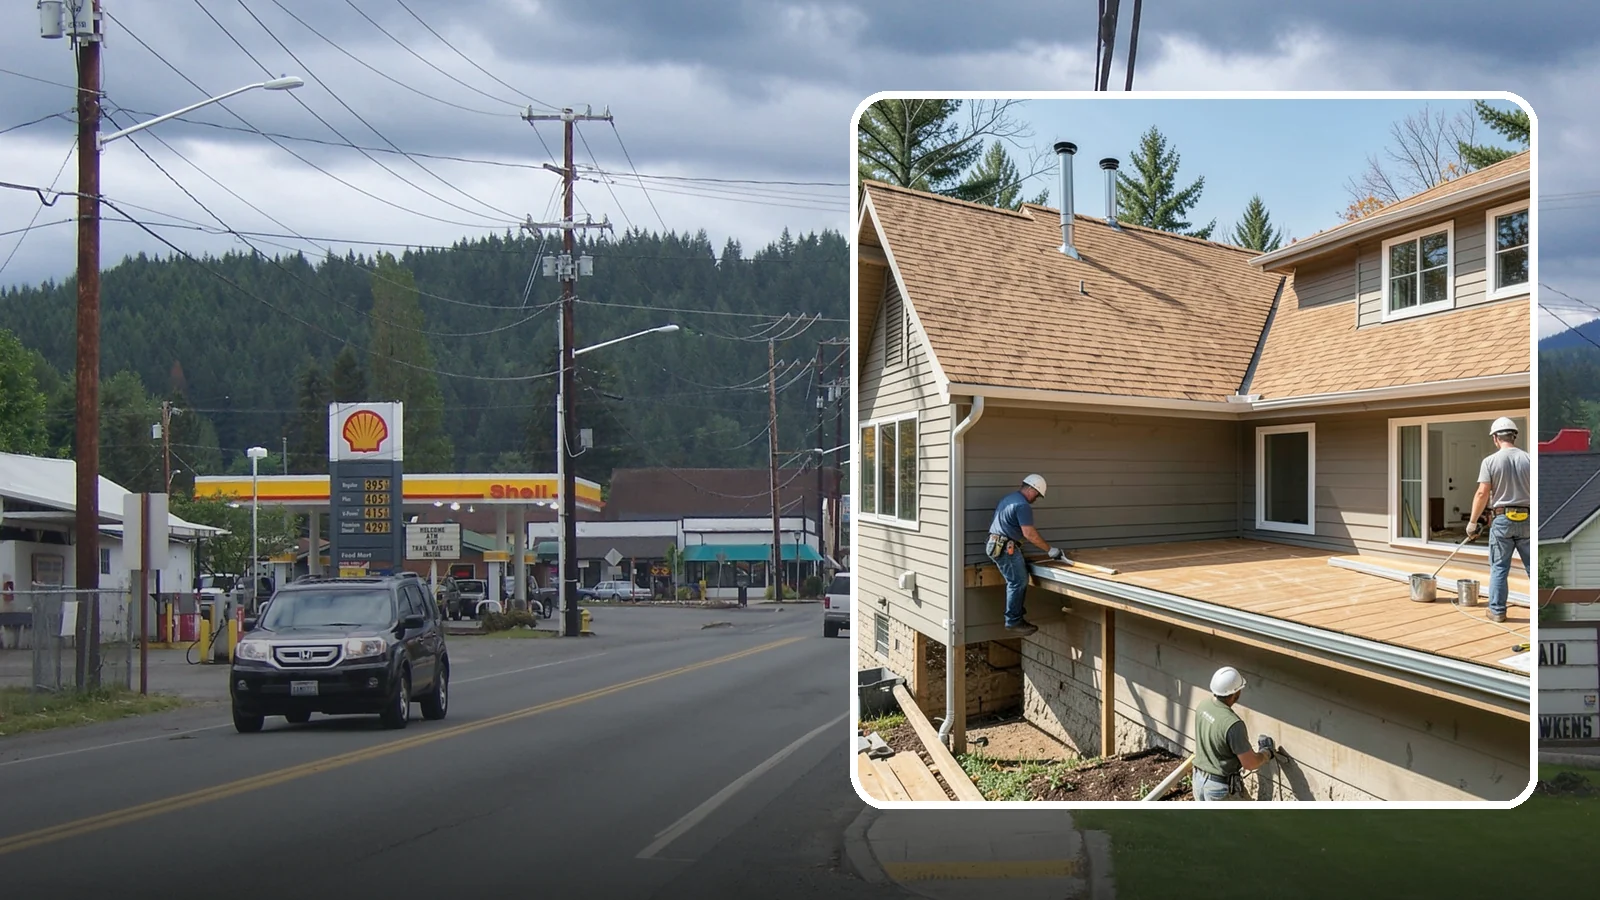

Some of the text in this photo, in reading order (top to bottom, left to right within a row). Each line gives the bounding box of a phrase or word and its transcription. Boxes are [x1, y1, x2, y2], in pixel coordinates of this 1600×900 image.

[366, 480, 384, 490] 395
[490, 484, 547, 499] Shell
[366, 494, 384, 504] 405
[366, 508, 384, 518] 415
[366, 522, 384, 532] 429
[1538, 643, 1566, 665] AID
[1538, 716, 1592, 739] WKENS
